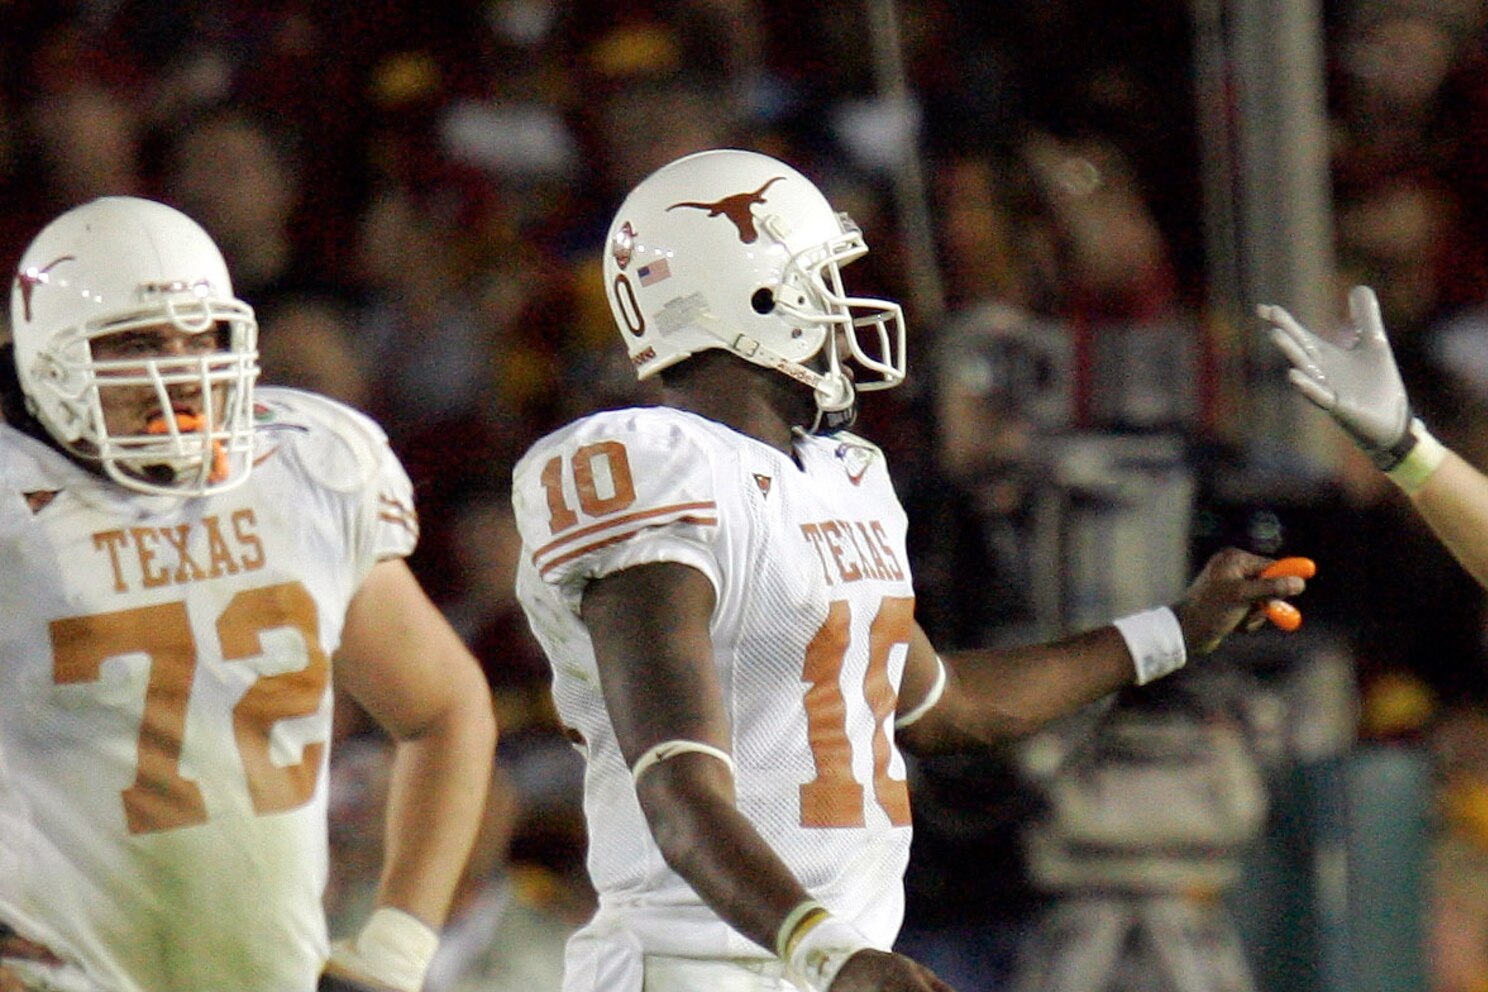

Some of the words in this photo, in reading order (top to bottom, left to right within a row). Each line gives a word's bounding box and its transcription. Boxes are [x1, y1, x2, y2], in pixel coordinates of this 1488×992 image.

[541, 441, 637, 534] 10
[93, 510, 265, 592] TEXAS
[802, 521, 905, 584] TEXAS
[49, 582, 329, 836] 72
